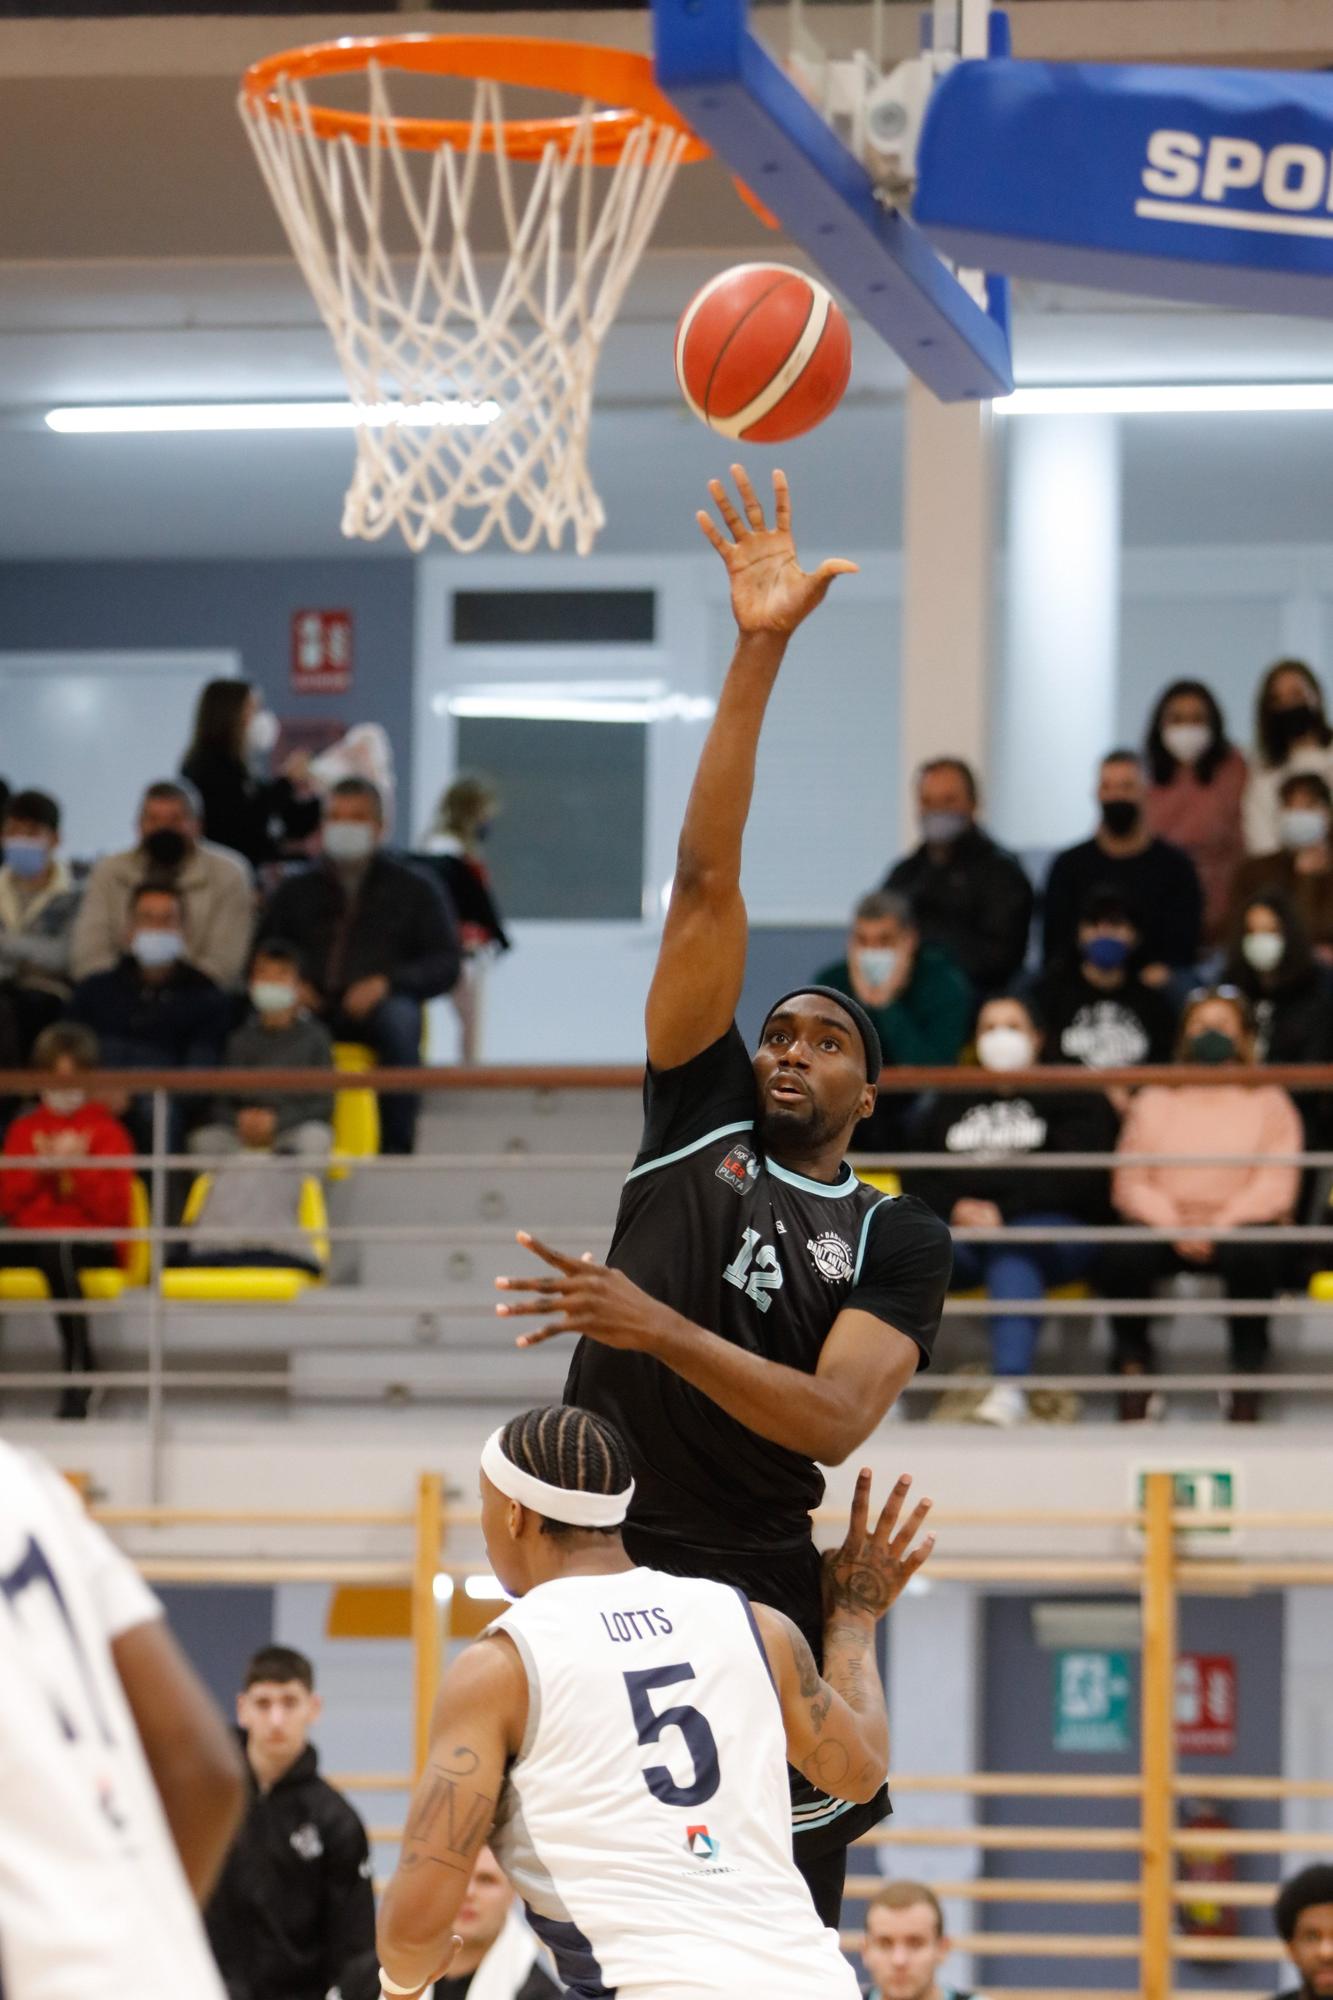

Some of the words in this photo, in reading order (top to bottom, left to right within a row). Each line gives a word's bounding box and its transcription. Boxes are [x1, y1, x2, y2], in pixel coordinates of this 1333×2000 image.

[1141, 129, 1333, 214] SPO
[719, 1167, 744, 1190] PLATA
[724, 1157, 746, 1180] LEB
[722, 1226, 783, 1313] 12
[600, 1607, 673, 1642] LOTTS
[622, 1662, 720, 1807] 5
